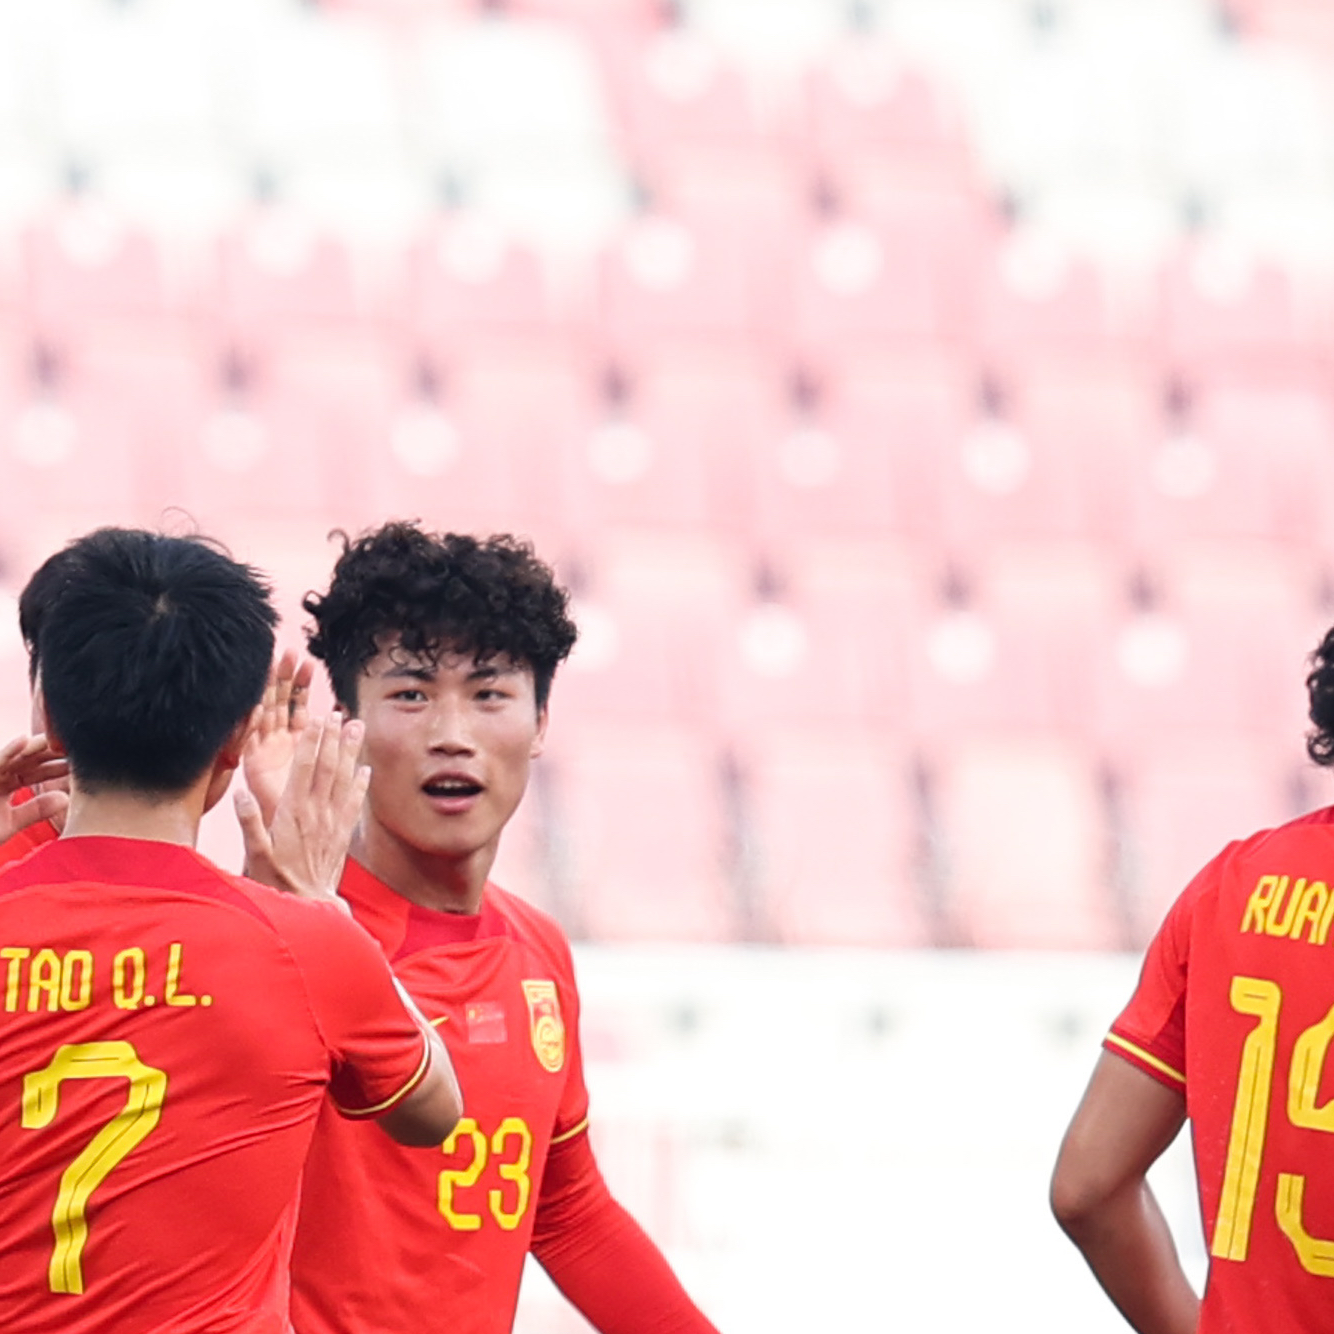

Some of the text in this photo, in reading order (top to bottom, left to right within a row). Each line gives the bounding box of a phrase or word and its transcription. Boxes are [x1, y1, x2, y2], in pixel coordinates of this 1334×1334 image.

[0, 943, 212, 1012] TAO Q.L.
[21, 1040, 167, 1295] 7
[438, 1117, 532, 1231] 23
